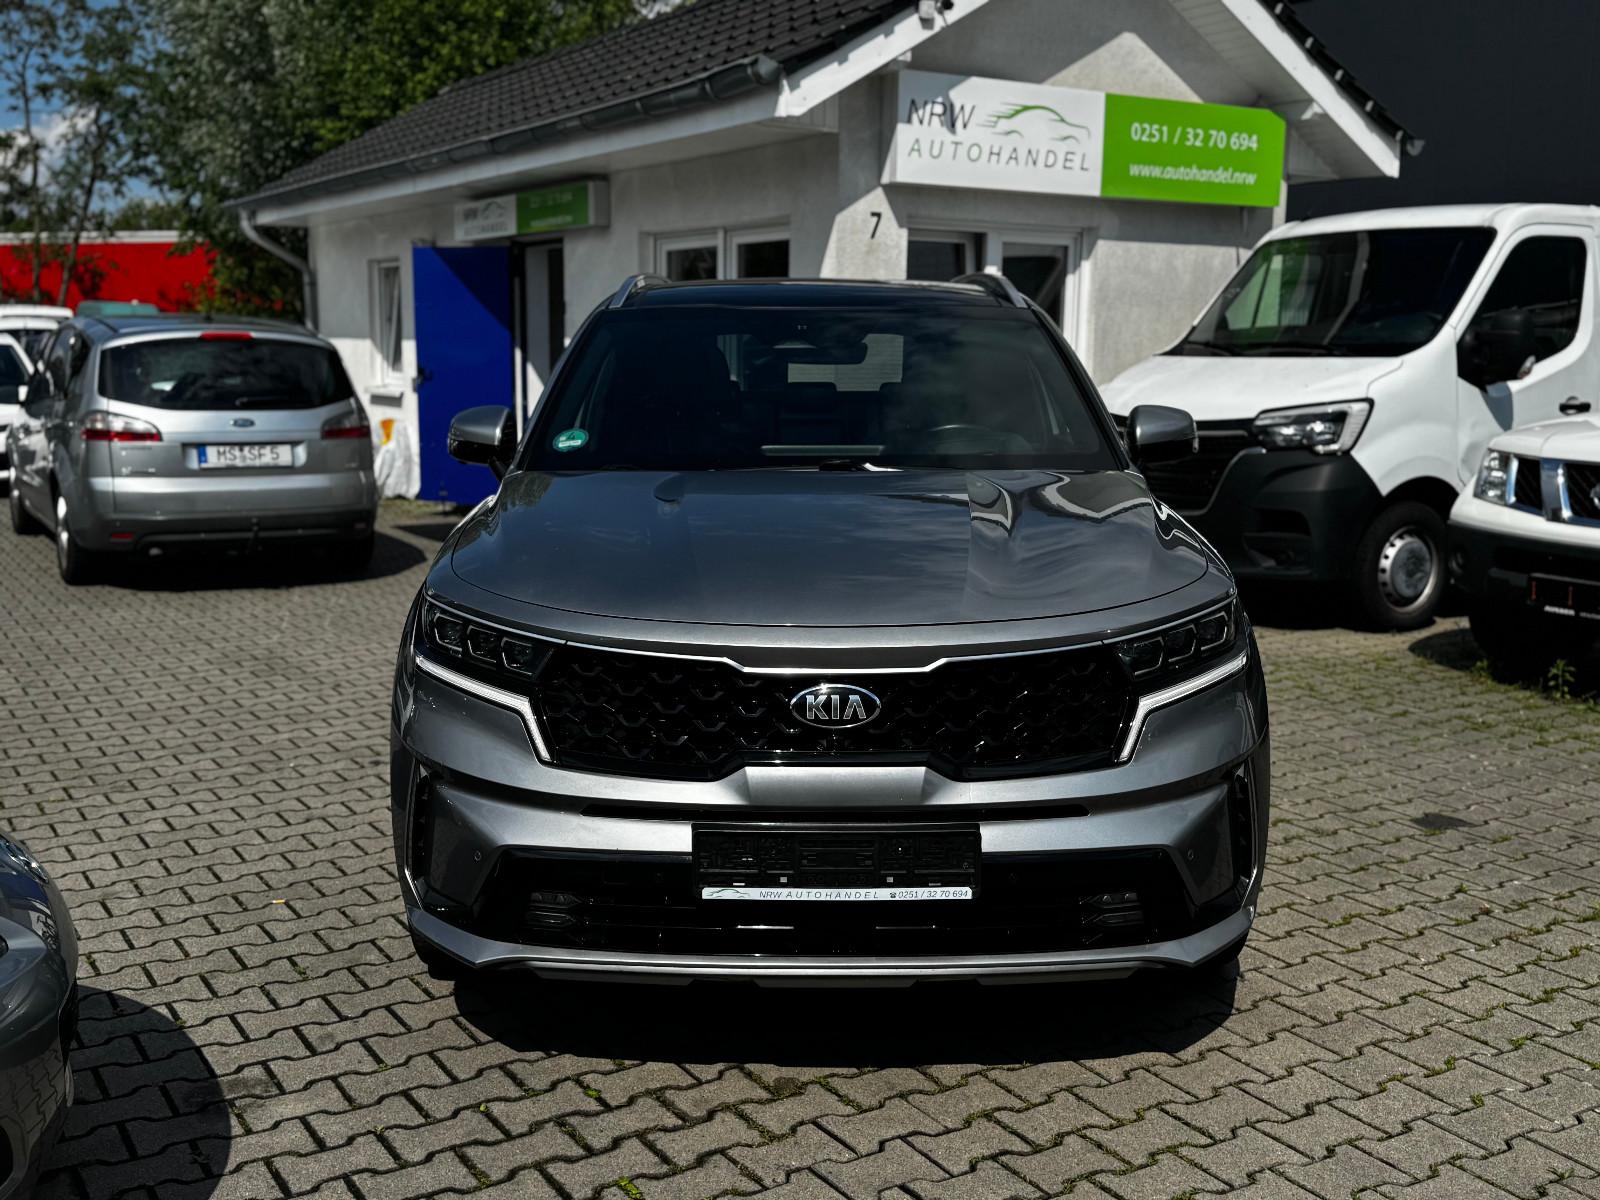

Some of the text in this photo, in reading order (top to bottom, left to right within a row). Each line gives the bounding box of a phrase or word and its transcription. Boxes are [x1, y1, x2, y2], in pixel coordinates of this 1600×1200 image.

[906, 98, 976, 131] NRW
[1130, 121, 1259, 151] 0251 / 32 70 694
[907, 138, 1091, 172] AUTOHANDEL
[1129, 163, 1257, 185] www.autohandel.nrw
[869, 211, 882, 240] 7
[270, 445, 280, 461] 5
[806, 695, 867, 720] KIA
[759, 890, 782, 899] NRW
[785, 891, 880, 899] AUTOHANDEL
[898, 890, 919, 899] 0251
[926, 890, 938, 898] 32
[940, 890, 951, 898] 70
[952, 890, 968, 898] 694
